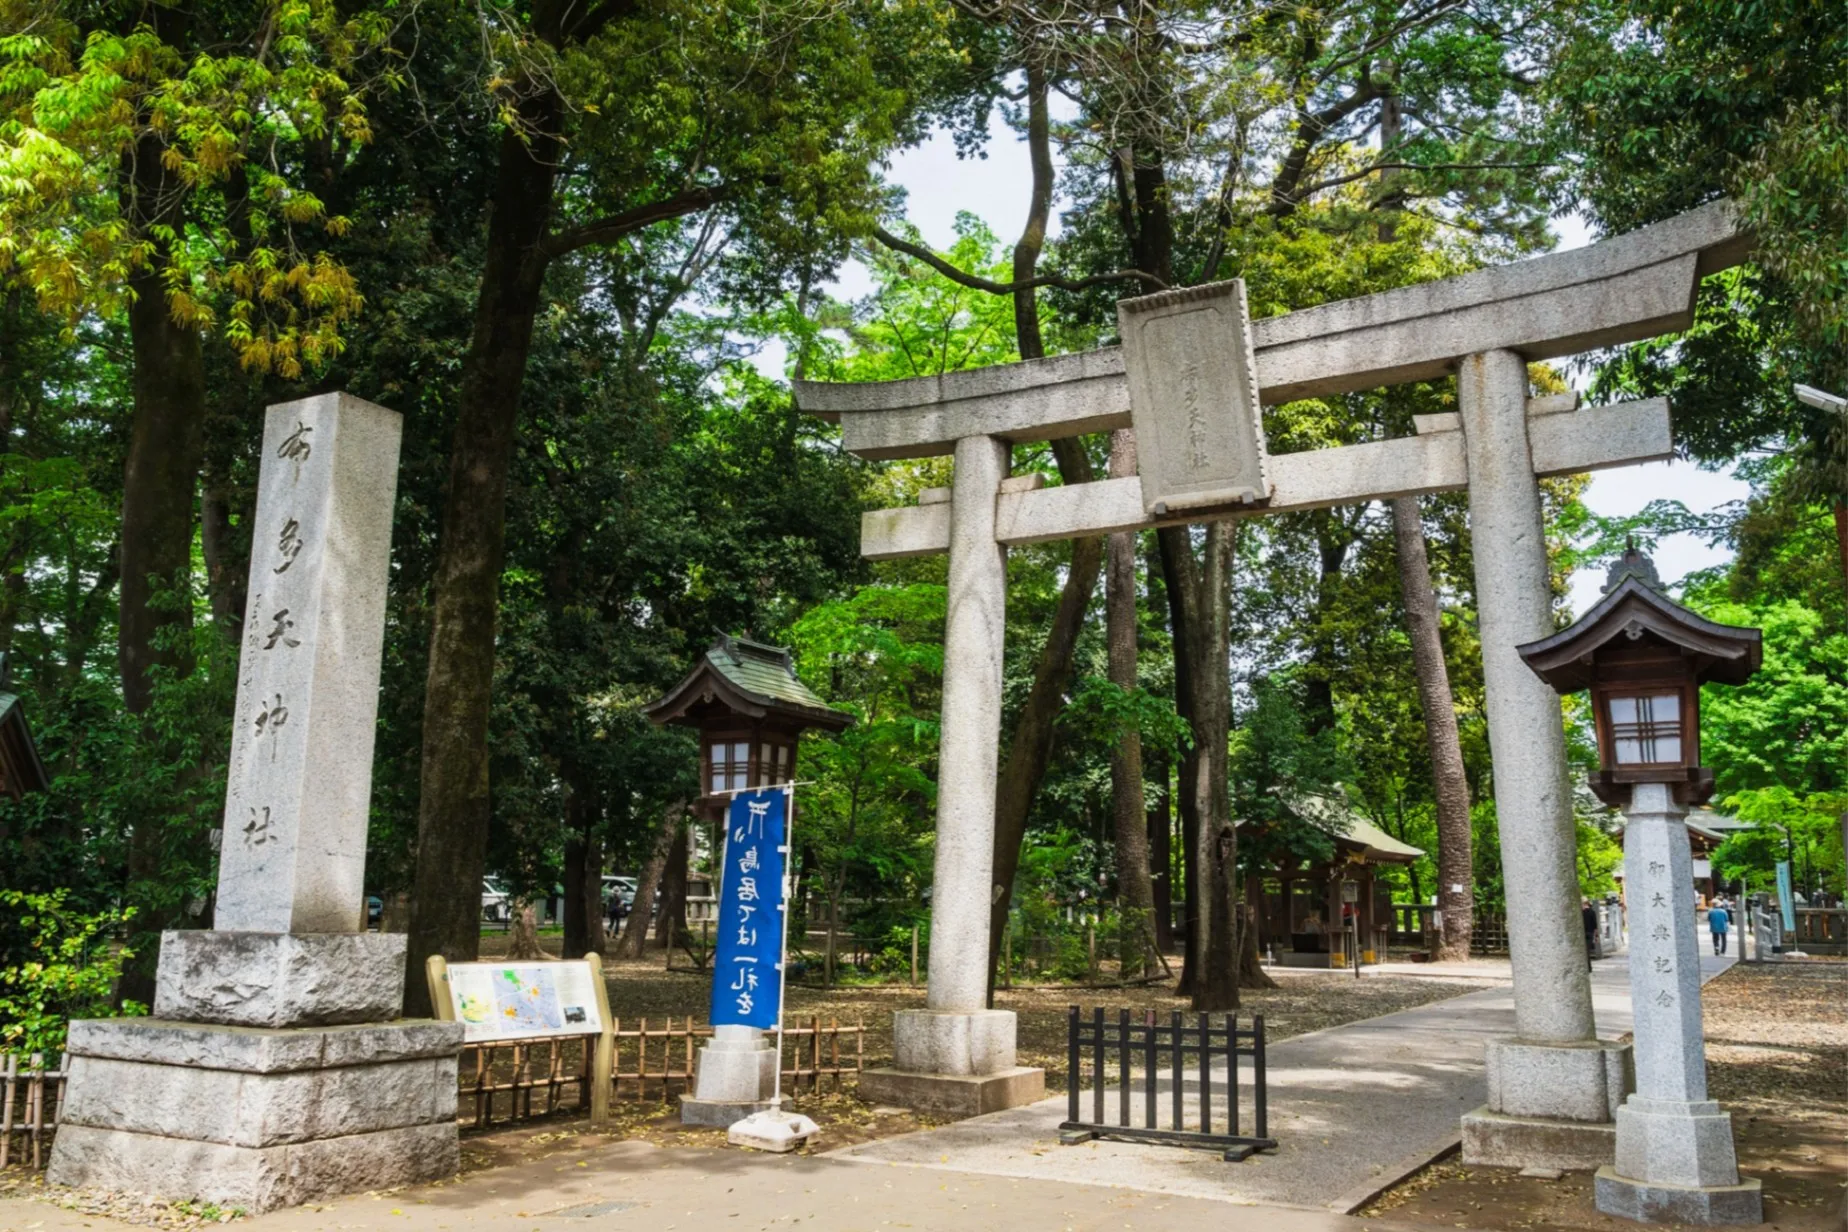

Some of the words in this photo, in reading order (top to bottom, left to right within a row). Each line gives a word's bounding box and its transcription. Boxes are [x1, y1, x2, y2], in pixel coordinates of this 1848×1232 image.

[242, 420, 313, 852] 布多天神社
[1648, 861, 1674, 1009] 御大典記念
